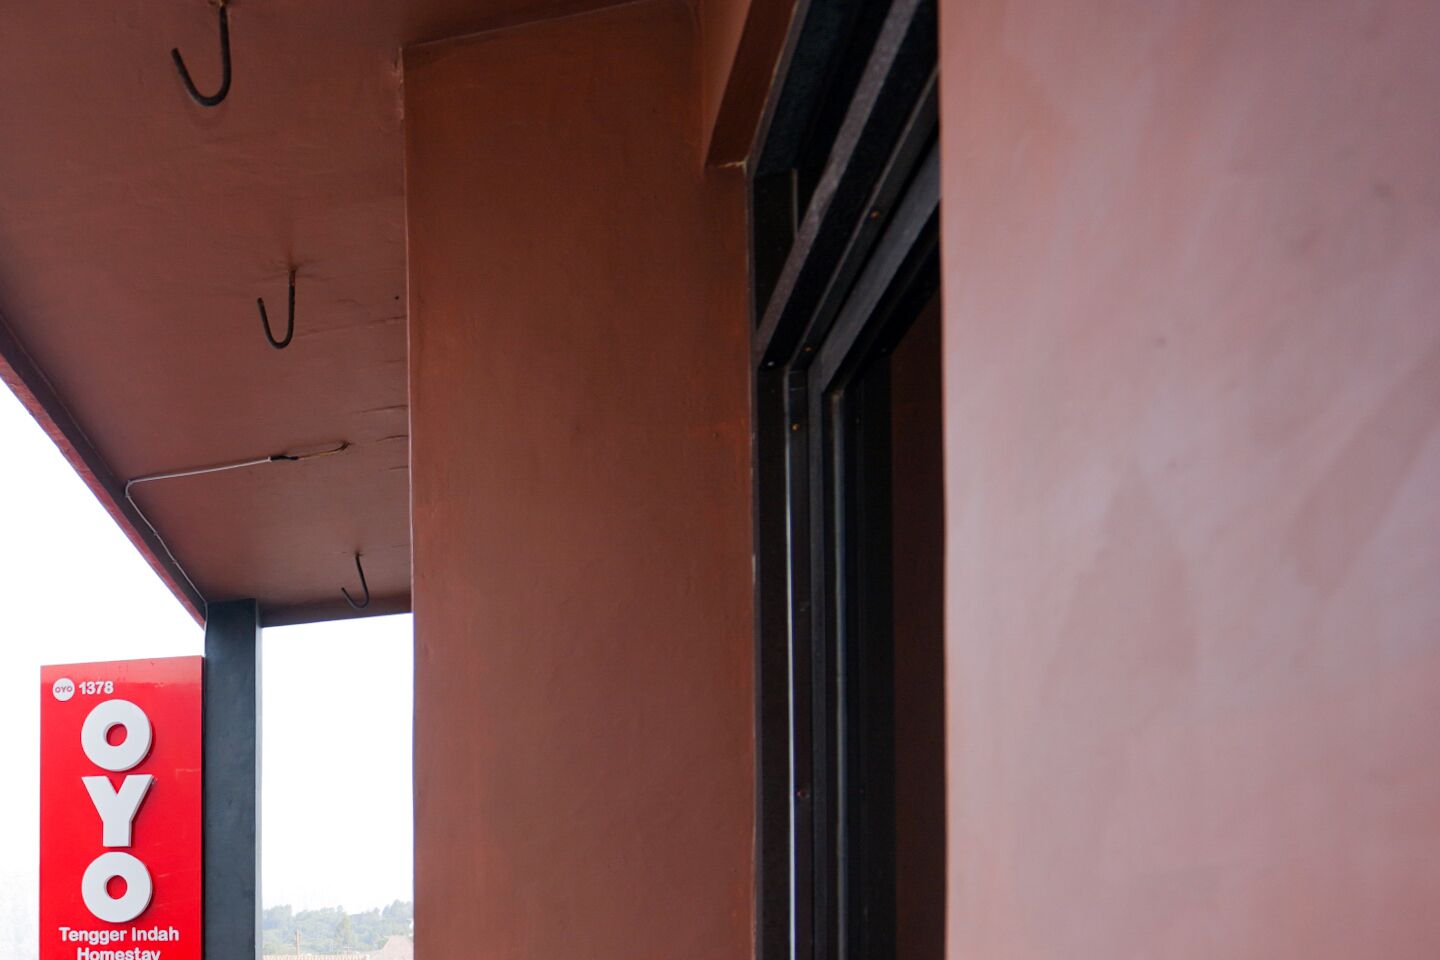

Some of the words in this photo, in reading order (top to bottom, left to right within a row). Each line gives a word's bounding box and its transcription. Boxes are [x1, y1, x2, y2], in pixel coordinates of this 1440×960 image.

[79, 680, 114, 695] 1378
[81, 699, 153, 922] OYO
[58, 926, 127, 945] Tengger
[132, 926, 179, 942] Indah
